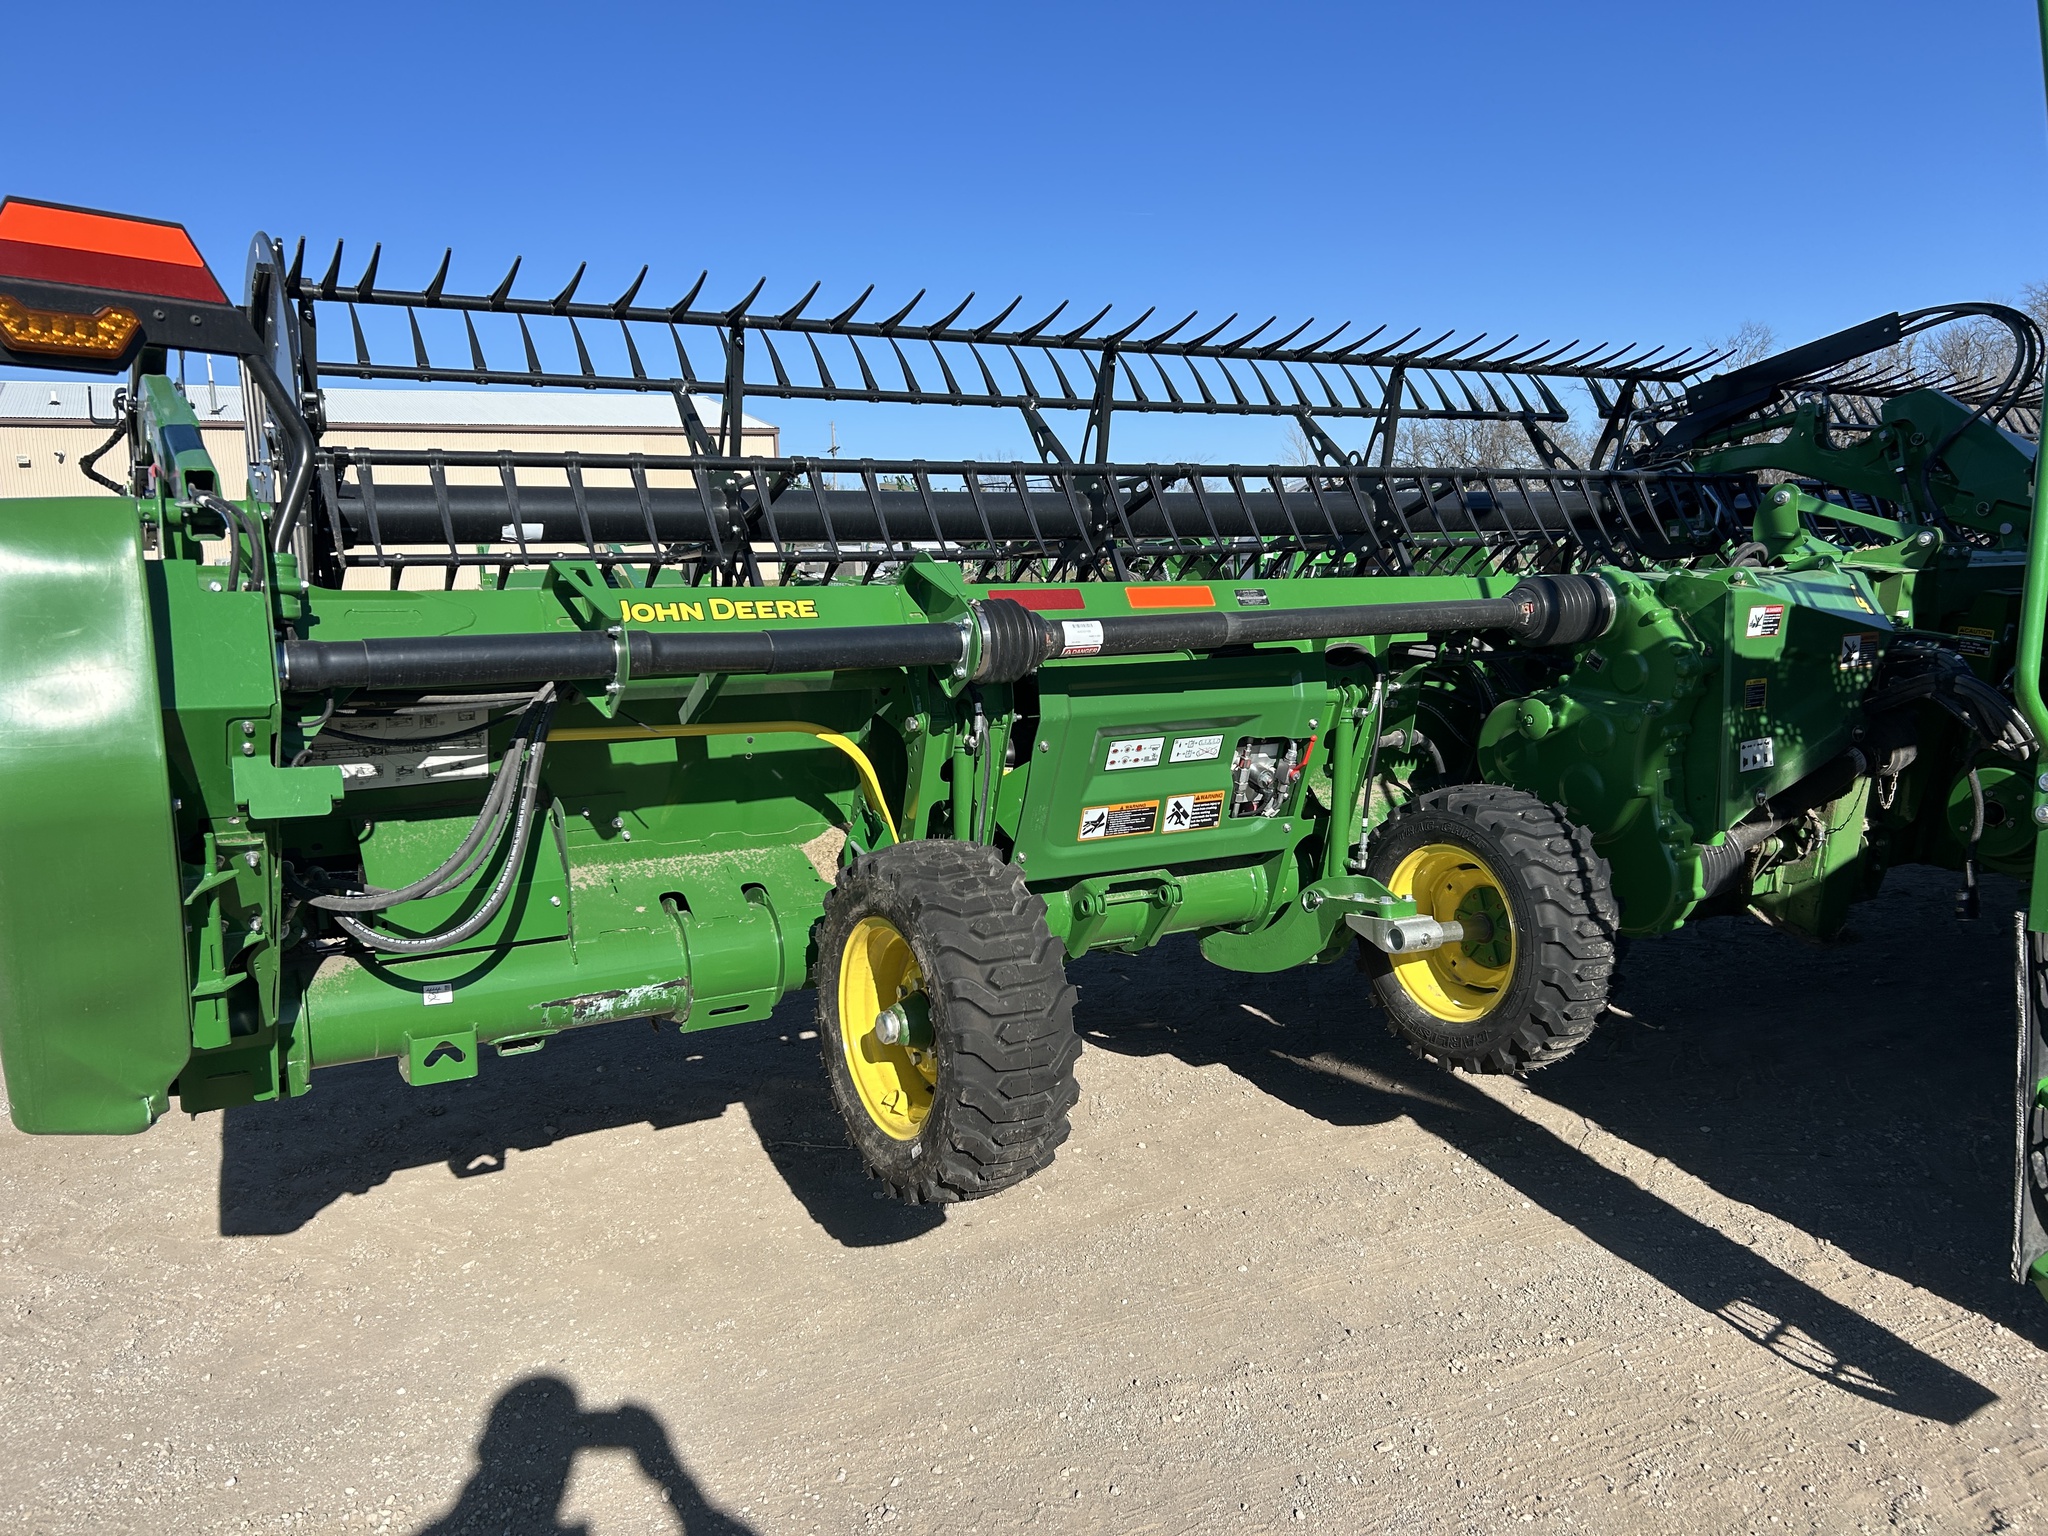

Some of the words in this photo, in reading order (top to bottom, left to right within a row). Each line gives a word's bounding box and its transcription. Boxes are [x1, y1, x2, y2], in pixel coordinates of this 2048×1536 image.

[619, 599, 705, 623] JOHN
[707, 598, 819, 620] DEERE
[1964, 628, 1992, 636] CAUTION
[1071, 647, 1098, 655] DANGER
[1200, 792, 1223, 800] WARNING
[1396, 1007, 1488, 1049] CARLISLE
